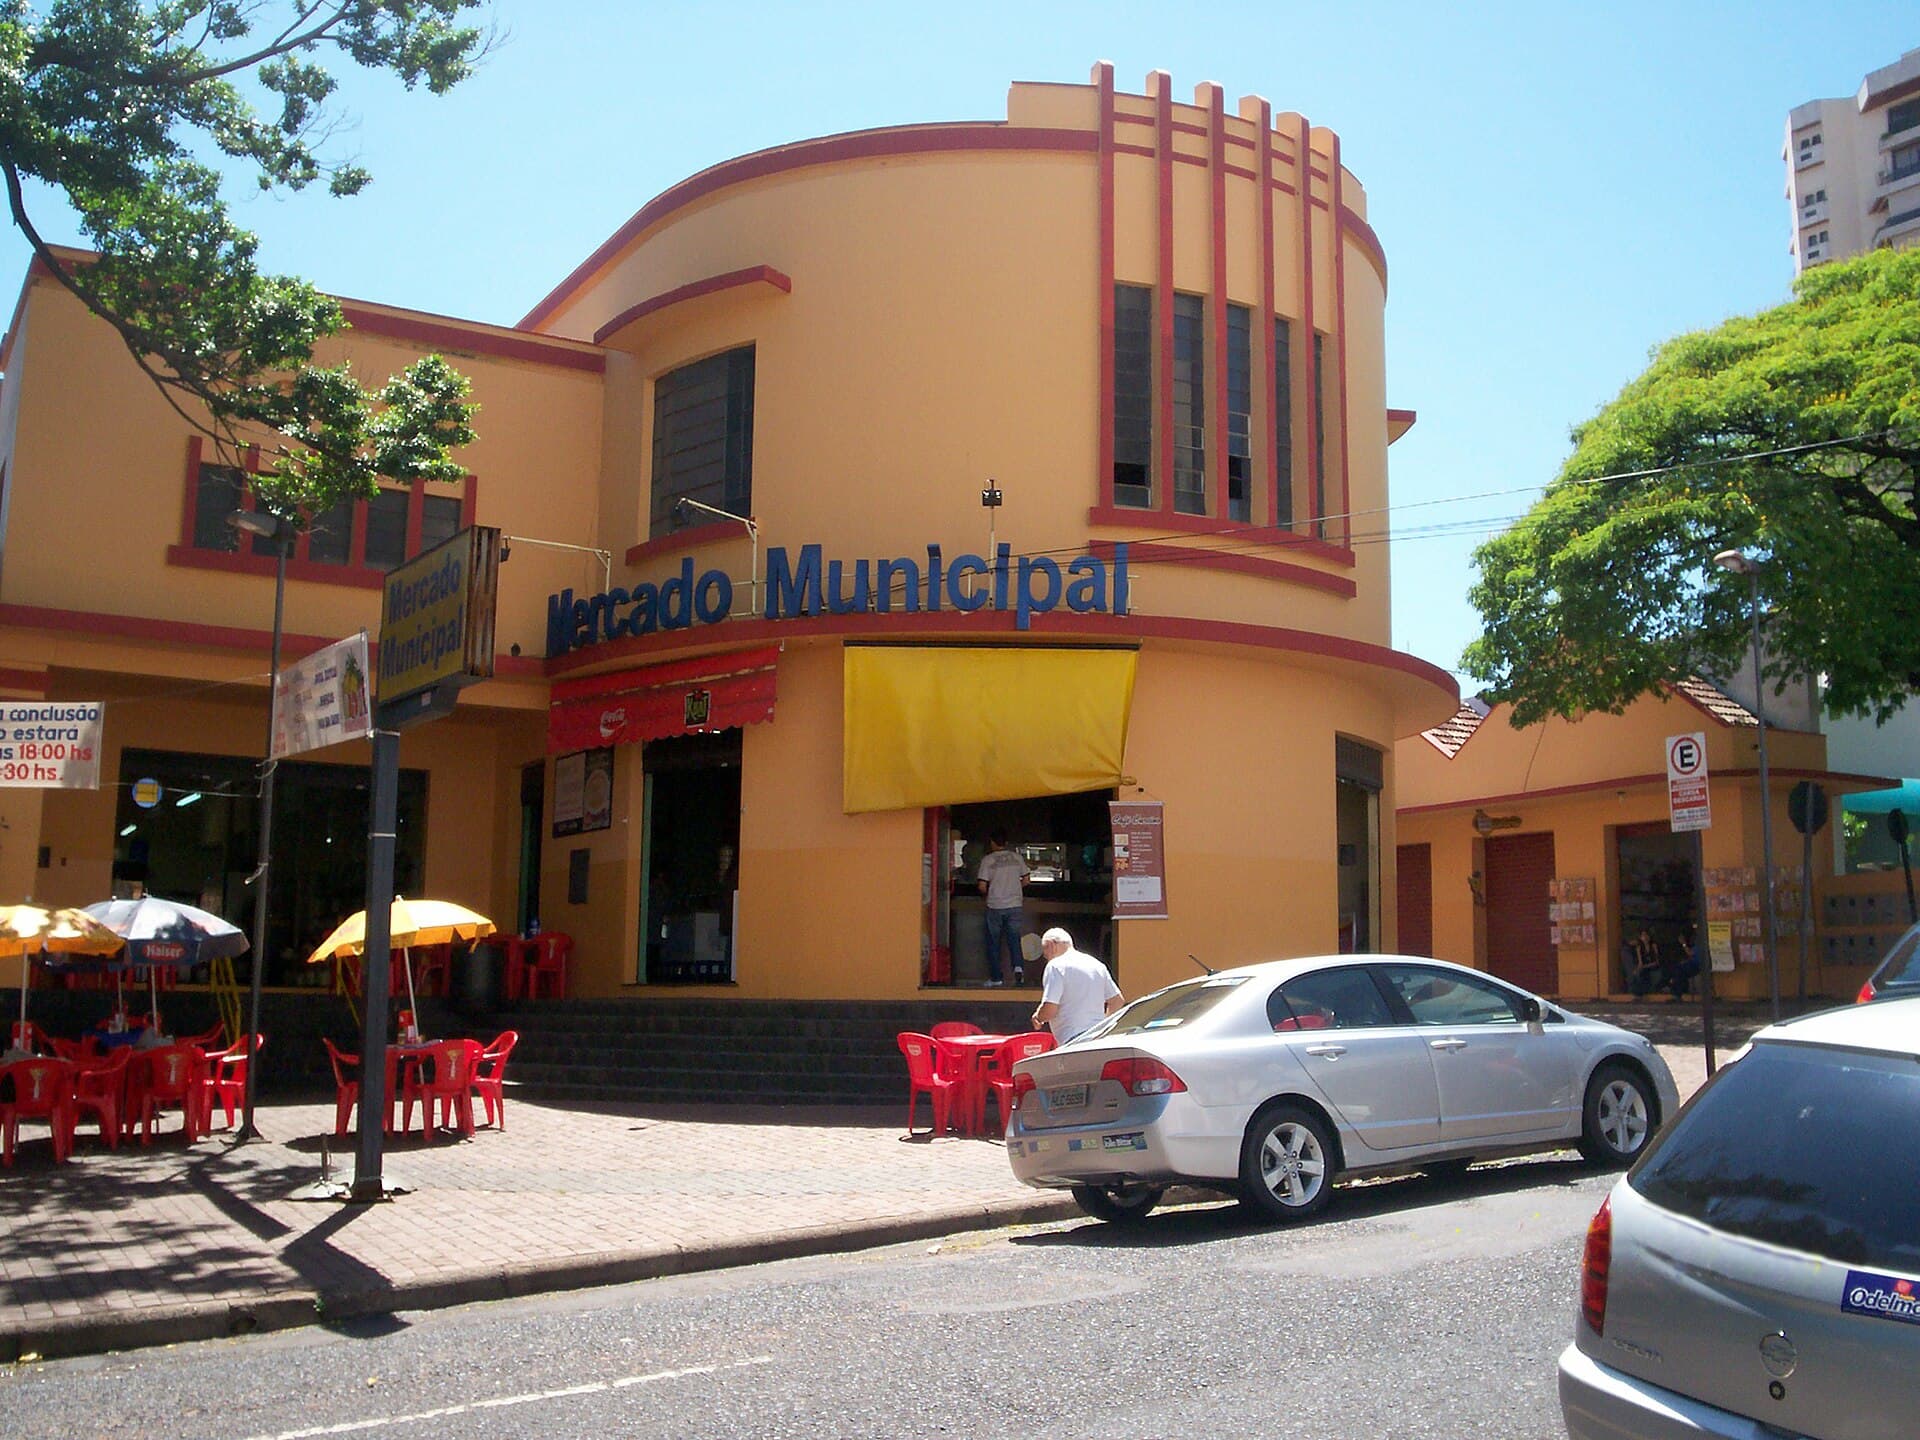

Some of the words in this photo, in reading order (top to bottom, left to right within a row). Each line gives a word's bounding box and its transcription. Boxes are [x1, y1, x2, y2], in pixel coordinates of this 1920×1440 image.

[388, 552, 461, 625] Mercado
[545, 556, 733, 658] Mercado
[764, 542, 1129, 631] Municipal
[382, 603, 463, 680] Municipal
[9, 704, 99, 722] conclusão
[13, 724, 79, 741] estará
[19, 743, 66, 760] 18:00
[70, 744, 93, 761] hs
[1679, 744, 1695, 768] E
